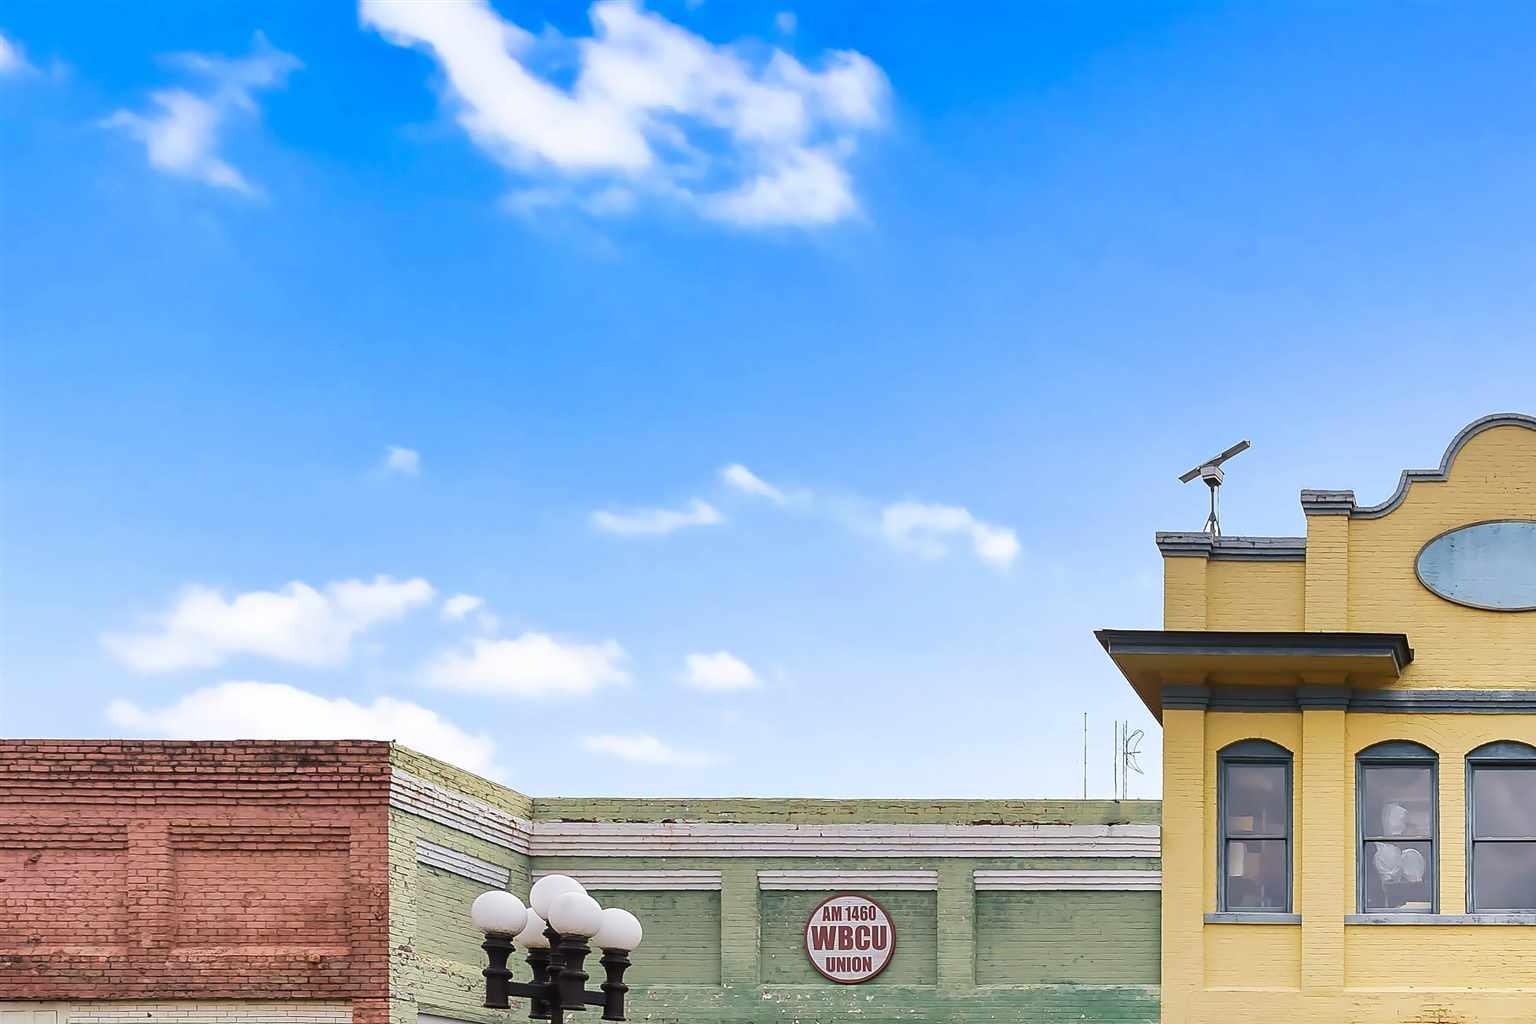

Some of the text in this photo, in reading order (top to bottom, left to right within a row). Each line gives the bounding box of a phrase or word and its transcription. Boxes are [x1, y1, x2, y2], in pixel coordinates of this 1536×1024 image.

[822, 905, 877, 921] AM 1460
[810, 924, 887, 951] WBCU
[825, 956, 872, 972] UNION
